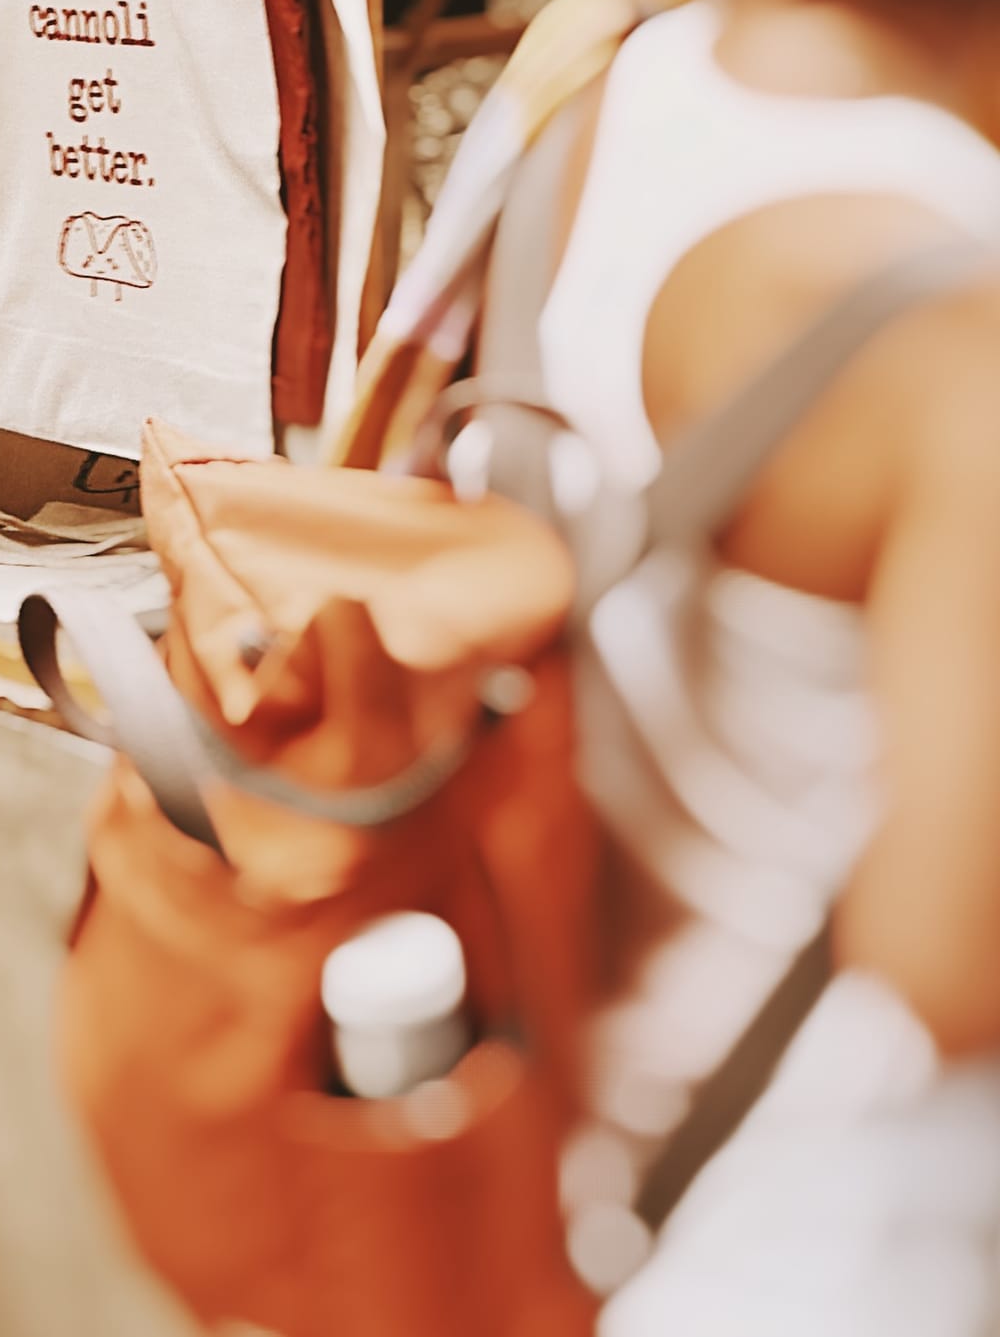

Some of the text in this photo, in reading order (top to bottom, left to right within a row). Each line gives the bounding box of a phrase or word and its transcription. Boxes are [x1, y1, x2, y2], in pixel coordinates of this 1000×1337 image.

[29, 0, 156, 48] cannoli
[68, 69, 122, 123] get
[45, 131, 155, 187] better.
